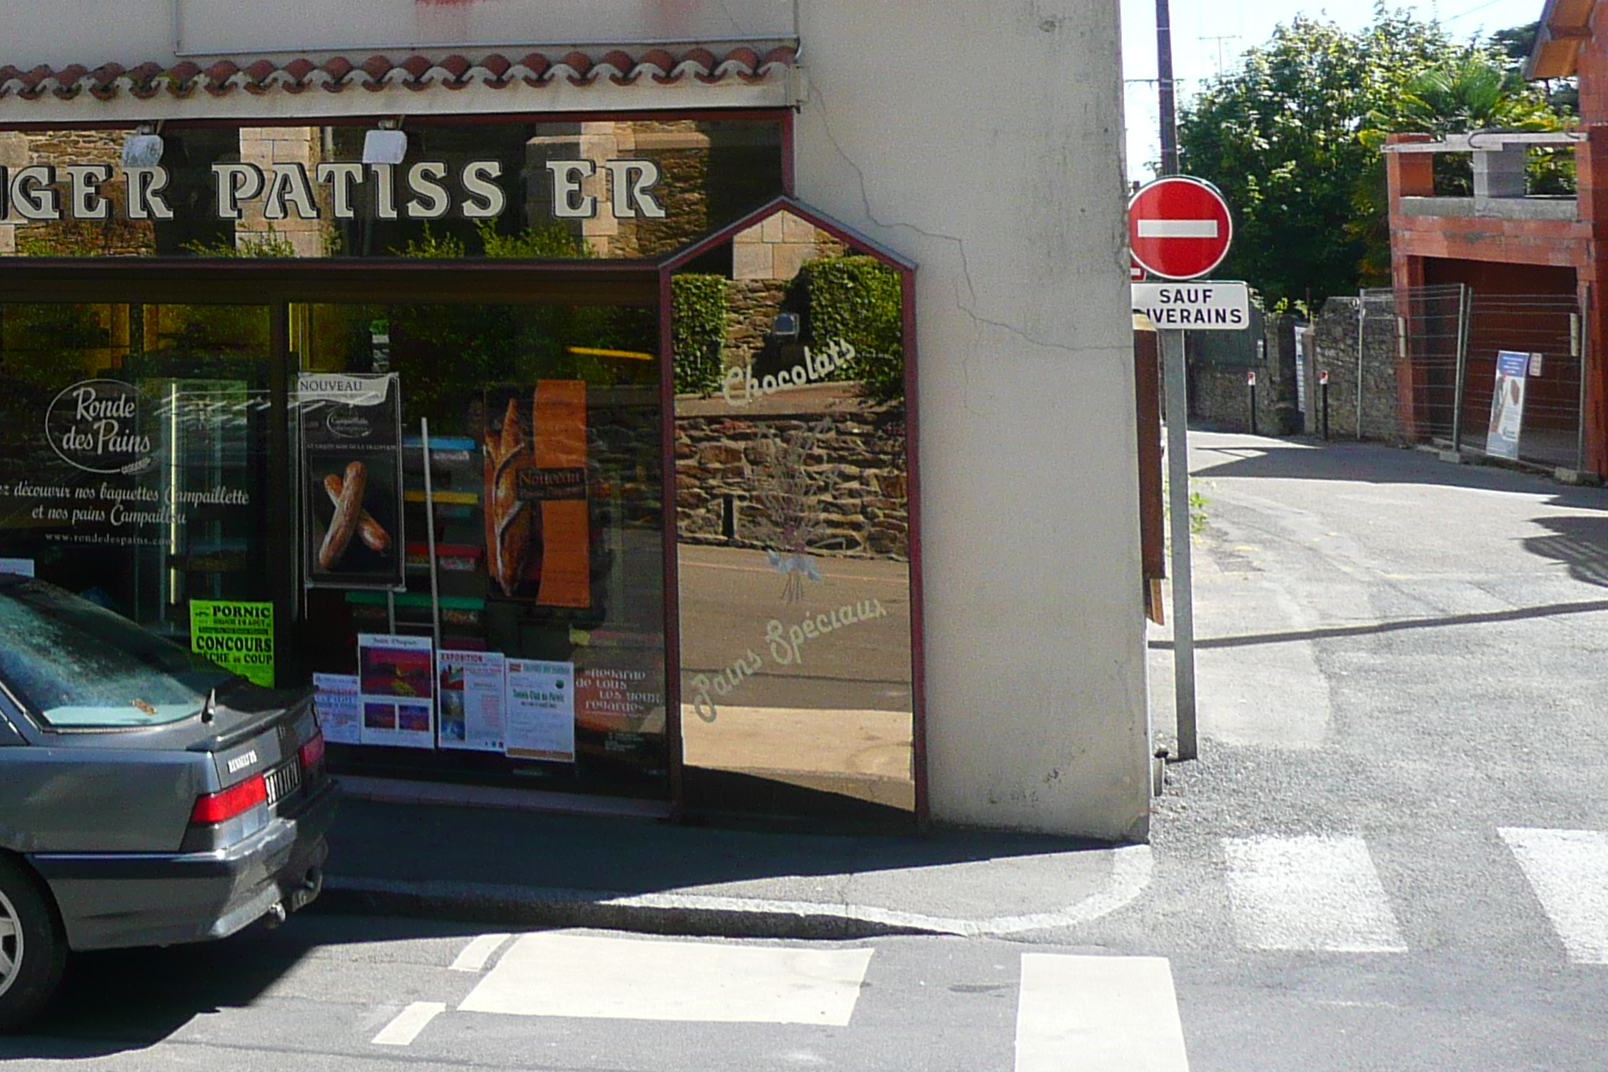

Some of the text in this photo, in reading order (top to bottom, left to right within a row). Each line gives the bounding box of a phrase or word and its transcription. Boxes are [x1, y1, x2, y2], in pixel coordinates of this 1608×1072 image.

[1159, 288, 1214, 304] SAUF
[722, 337, 856, 408] Chocolats
[300, 380, 363, 392] NOUVEAU
[72, 387, 136, 422] Ronde
[62, 418, 151, 456] des Pains
[14, 480, 71, 498] découvrir
[74, 488, 96, 500] nos
[99, 481, 159, 505] baguettes
[164, 484, 250, 509] Campaillette
[31, 504, 44, 520] et
[47, 508, 69, 520] nos
[71, 505, 106, 526] pains
[212, 605, 271, 619] PORNIC
[196, 635, 272, 653] CONCOURS
[243, 653, 272, 665] COUP
[441, 653, 484, 663] EXPOSITION
[692, 595, 888, 724] Pains Spéciaux
